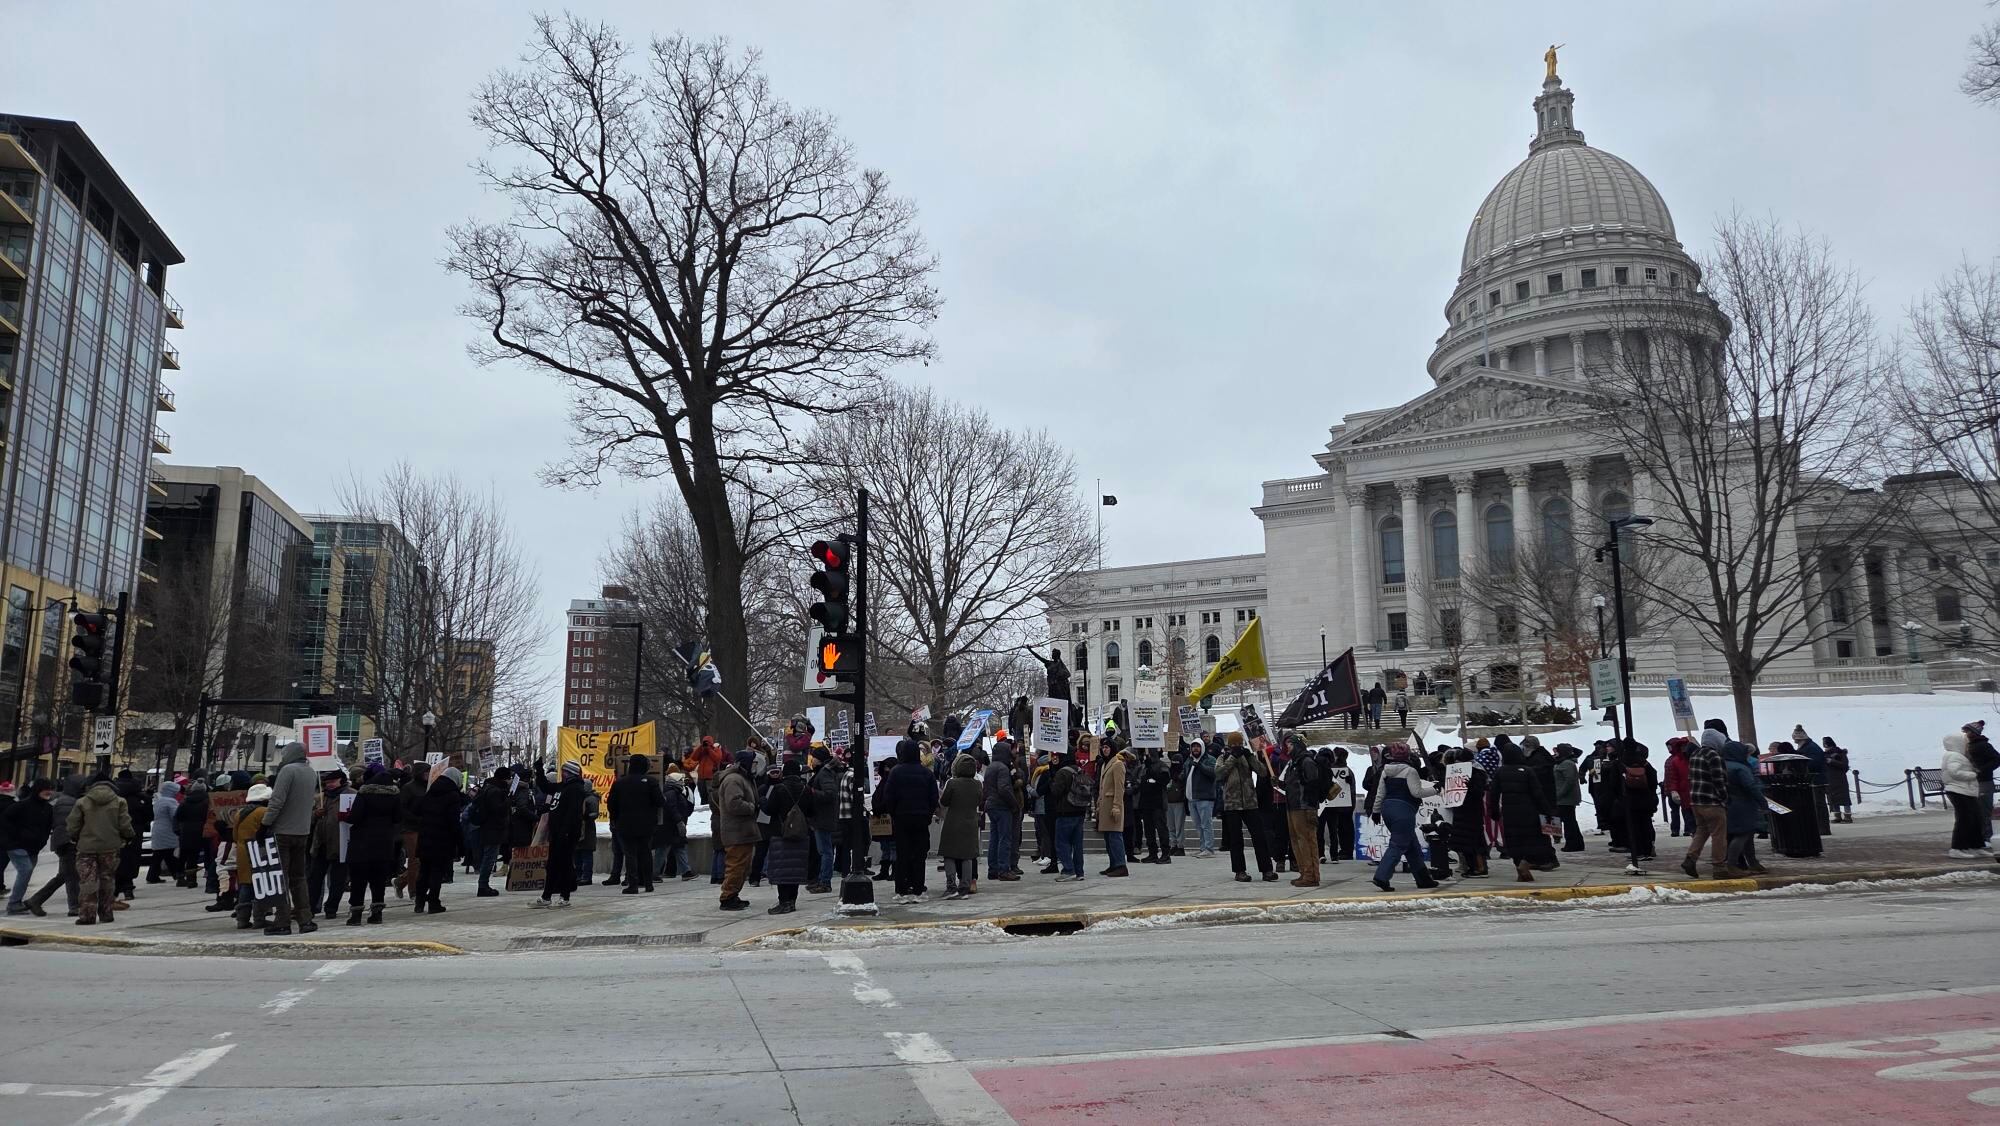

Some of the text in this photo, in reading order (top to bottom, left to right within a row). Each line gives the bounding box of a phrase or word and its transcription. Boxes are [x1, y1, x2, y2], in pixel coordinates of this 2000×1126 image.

[98, 720, 112, 730] ONE
[97, 731, 111, 740] WAY
[576, 731, 639, 749] ICE OUT
[609, 745, 629, 756] ICE
[580, 753, 594, 767] OF
[247, 837, 280, 868] ICE
[525, 870, 533, 879] IS
[252, 870, 283, 900] OUT
